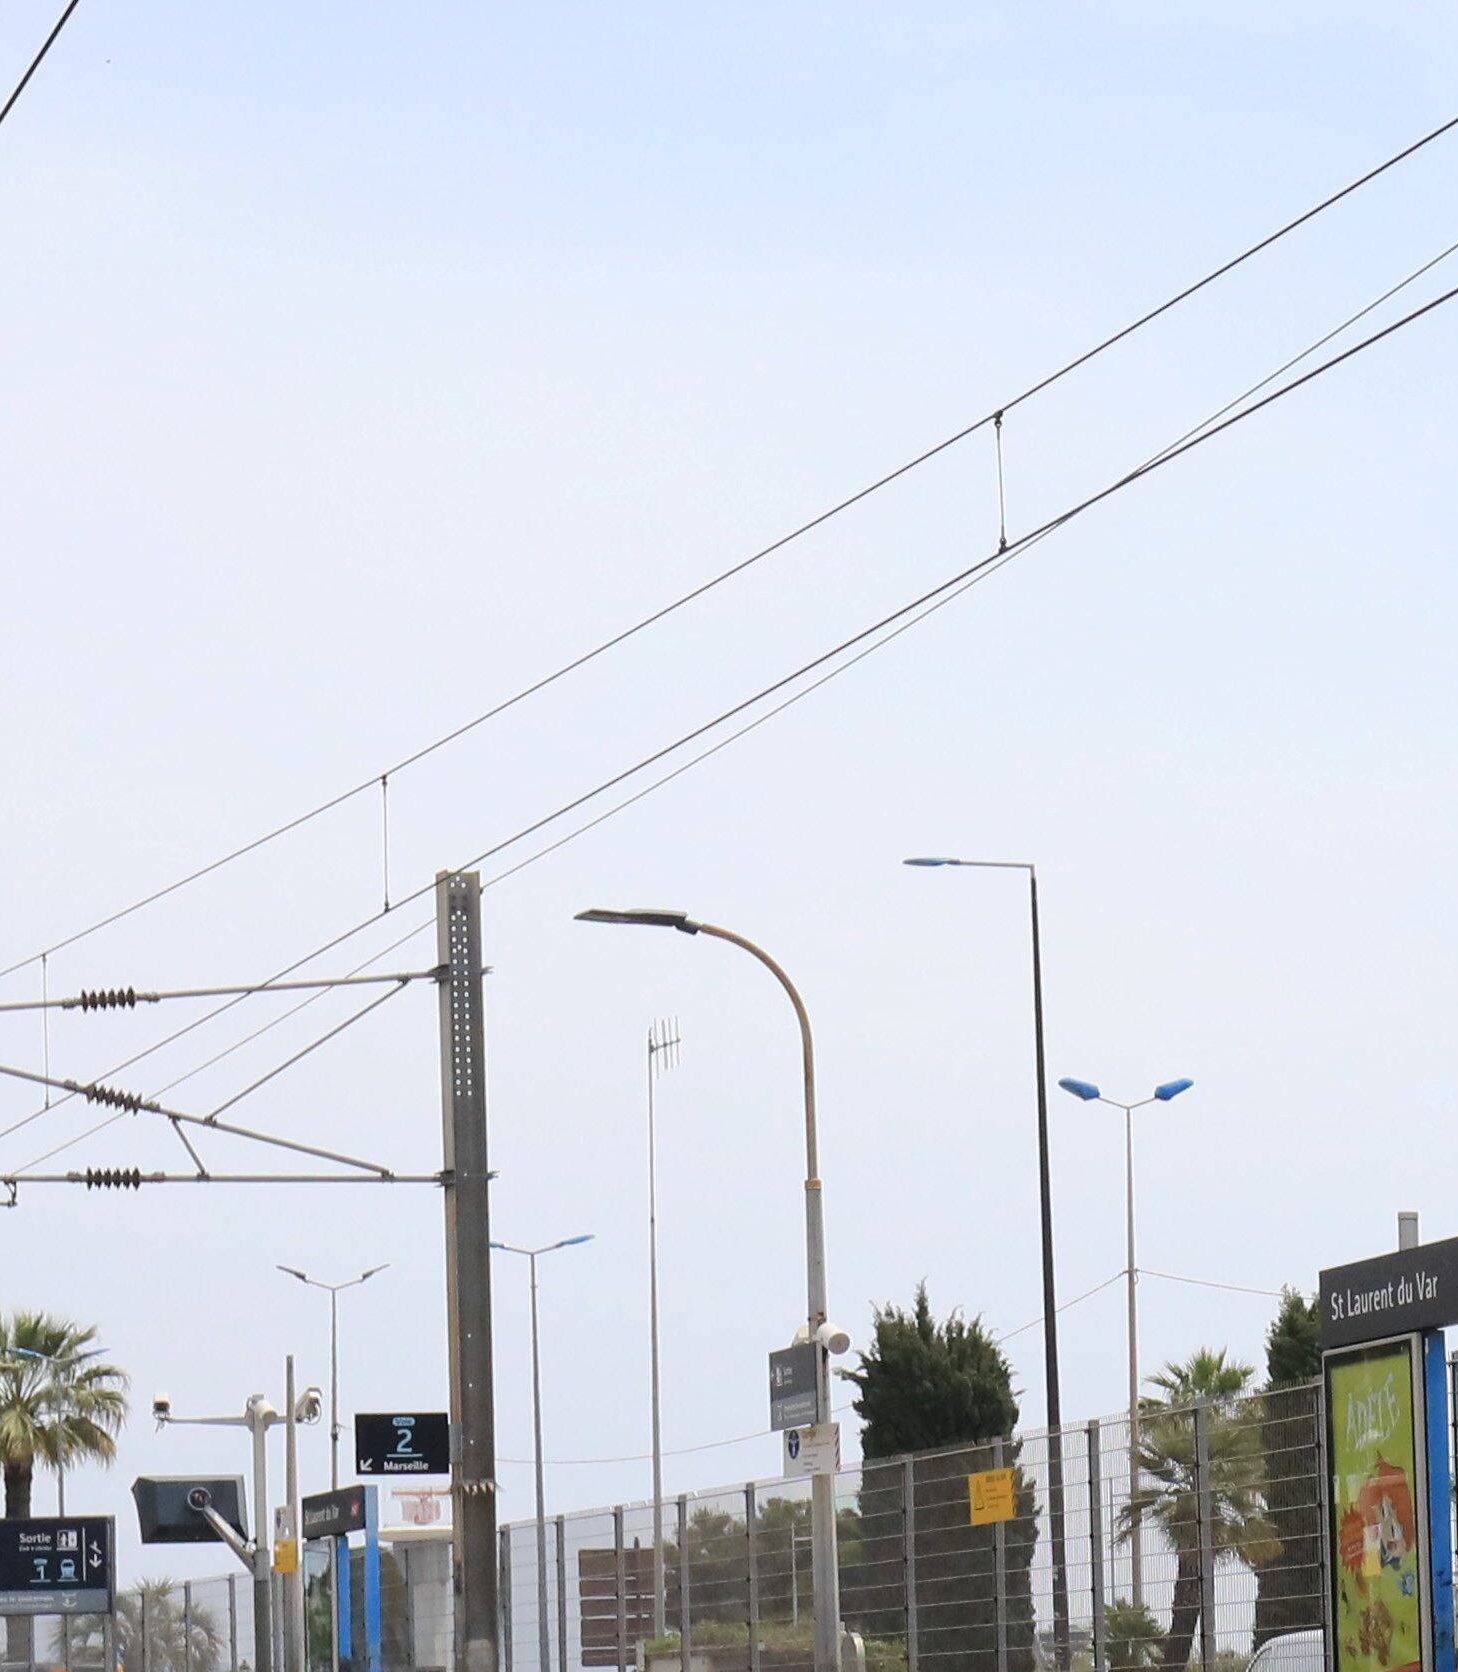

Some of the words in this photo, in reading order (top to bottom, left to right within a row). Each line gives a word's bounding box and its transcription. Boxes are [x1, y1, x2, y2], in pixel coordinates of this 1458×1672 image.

[1331, 1292, 1345, 1321] St
[1347, 1282, 1394, 1318] Laurent
[1397, 1276, 1413, 1306] du
[1416, 1270, 1438, 1300] Var
[396, 1428, 413, 1453] 2
[383, 1460, 429, 1471] Marseille
[19, 1532, 51, 1544] Sortie
